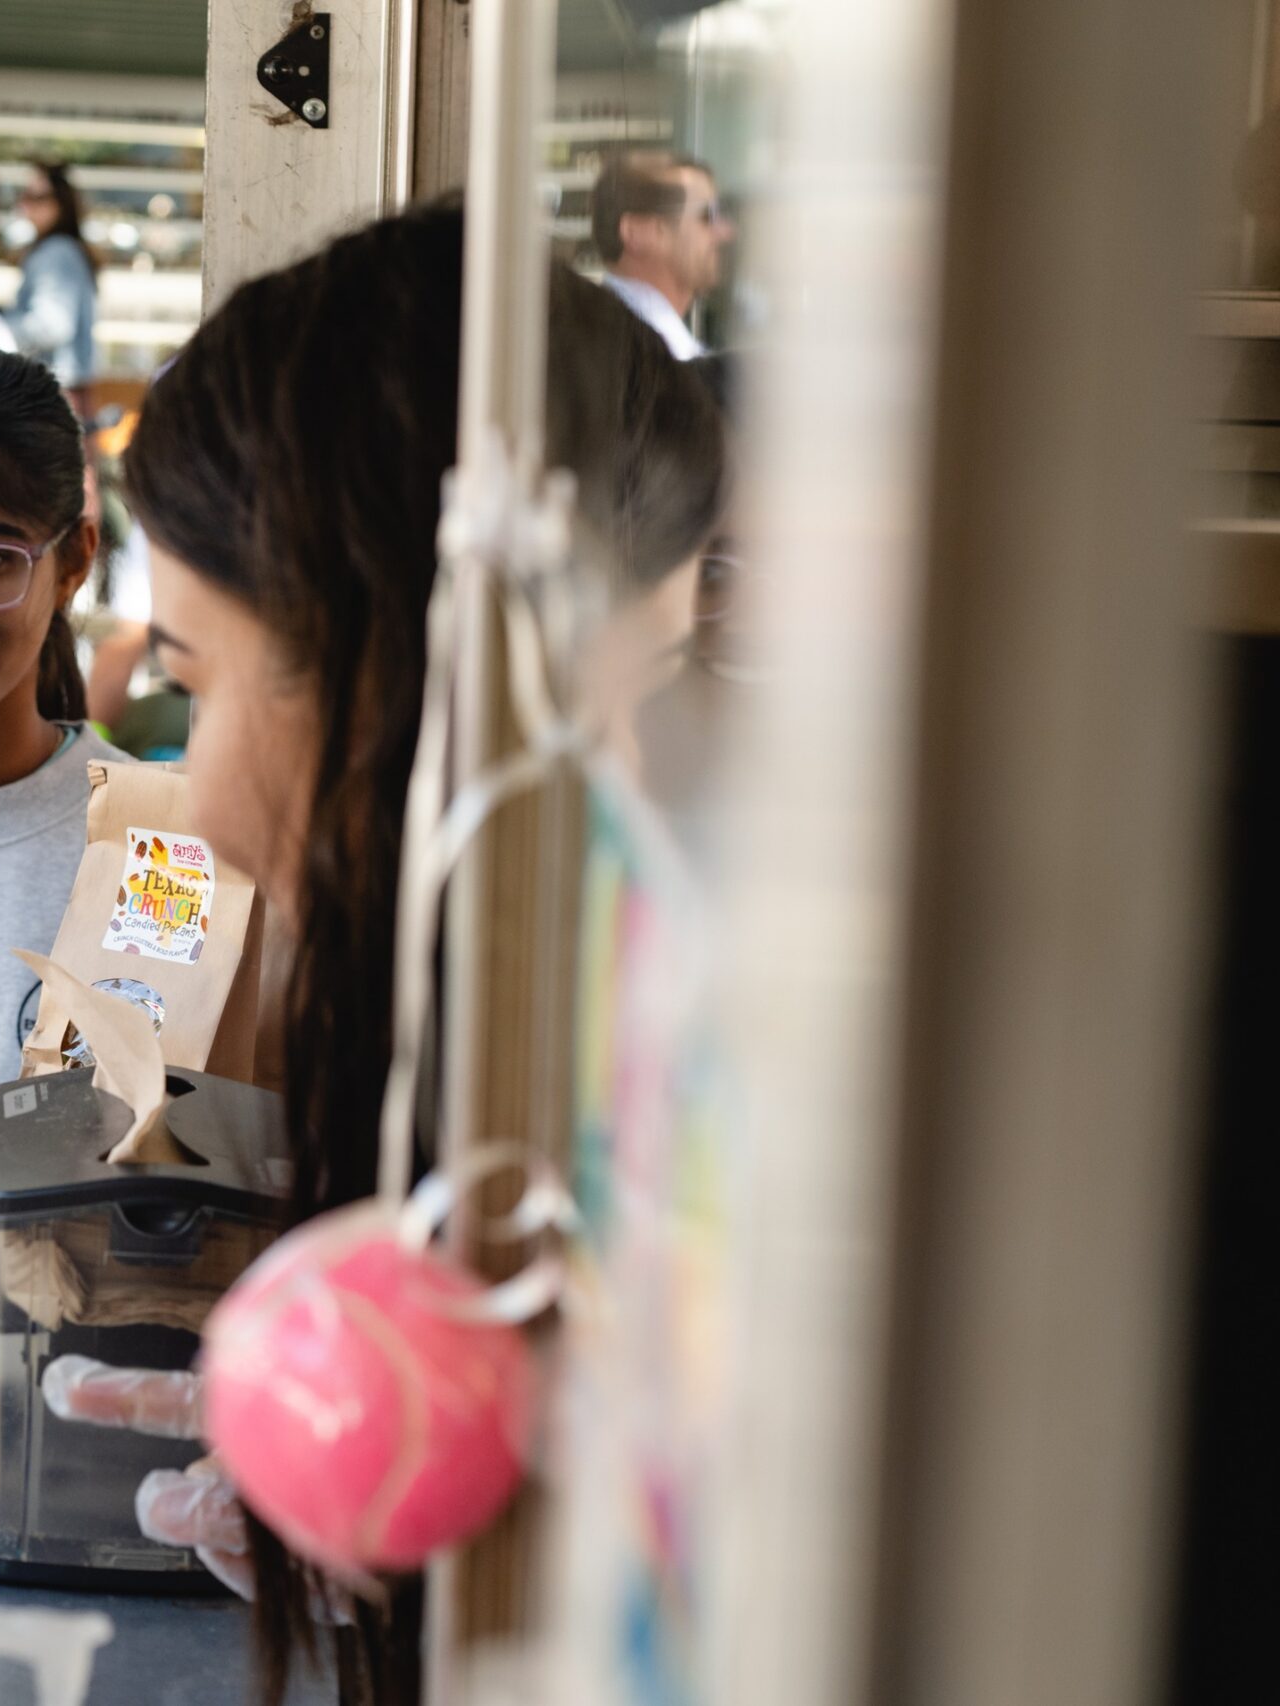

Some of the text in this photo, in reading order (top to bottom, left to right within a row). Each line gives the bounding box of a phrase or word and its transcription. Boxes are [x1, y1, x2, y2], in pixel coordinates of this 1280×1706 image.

[143, 869, 197, 897] TEXAS
[128, 893, 201, 925] CRUNCH
[124, 917, 197, 938] Candied Pecans
